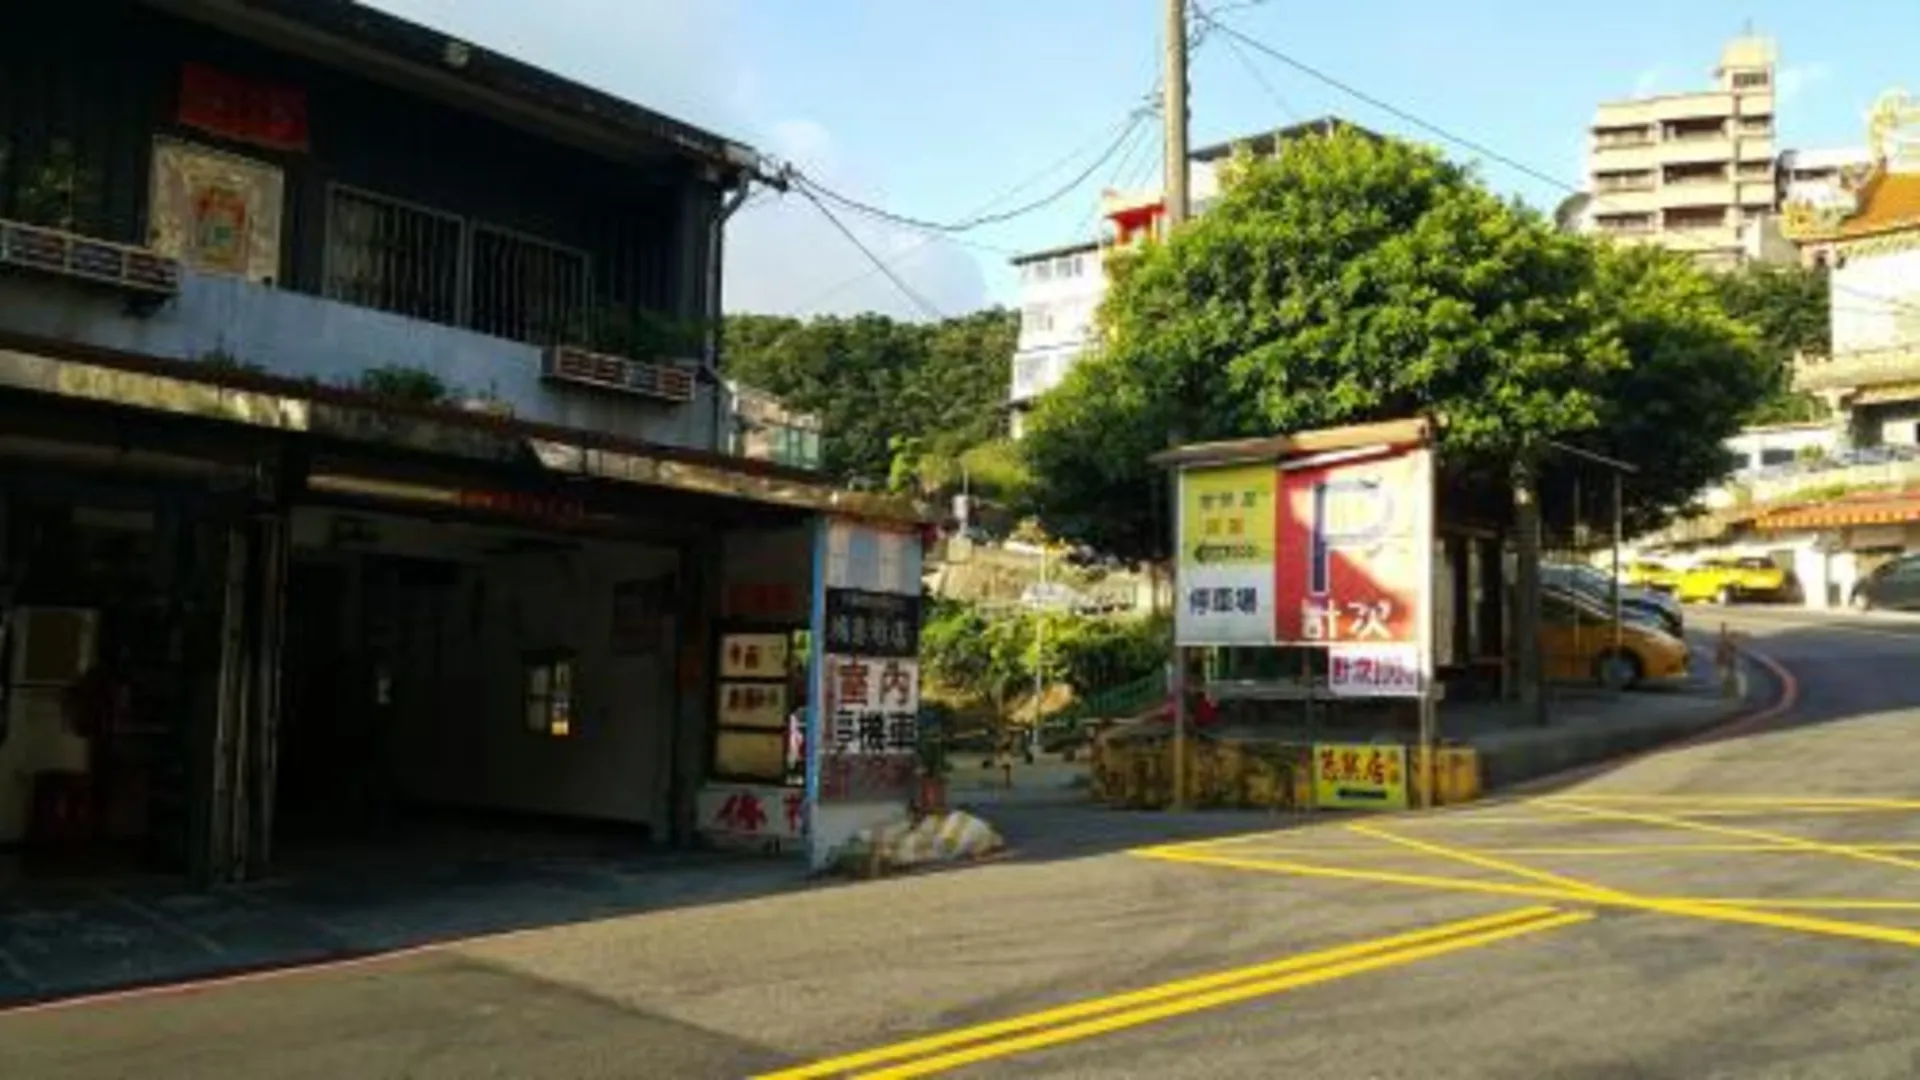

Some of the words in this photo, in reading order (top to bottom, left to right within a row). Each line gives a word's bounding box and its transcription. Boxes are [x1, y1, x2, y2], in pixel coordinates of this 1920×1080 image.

[1310, 479, 1396, 595] P
[1188, 586, 1258, 617] 停車場
[1300, 600, 1391, 641] 計次
